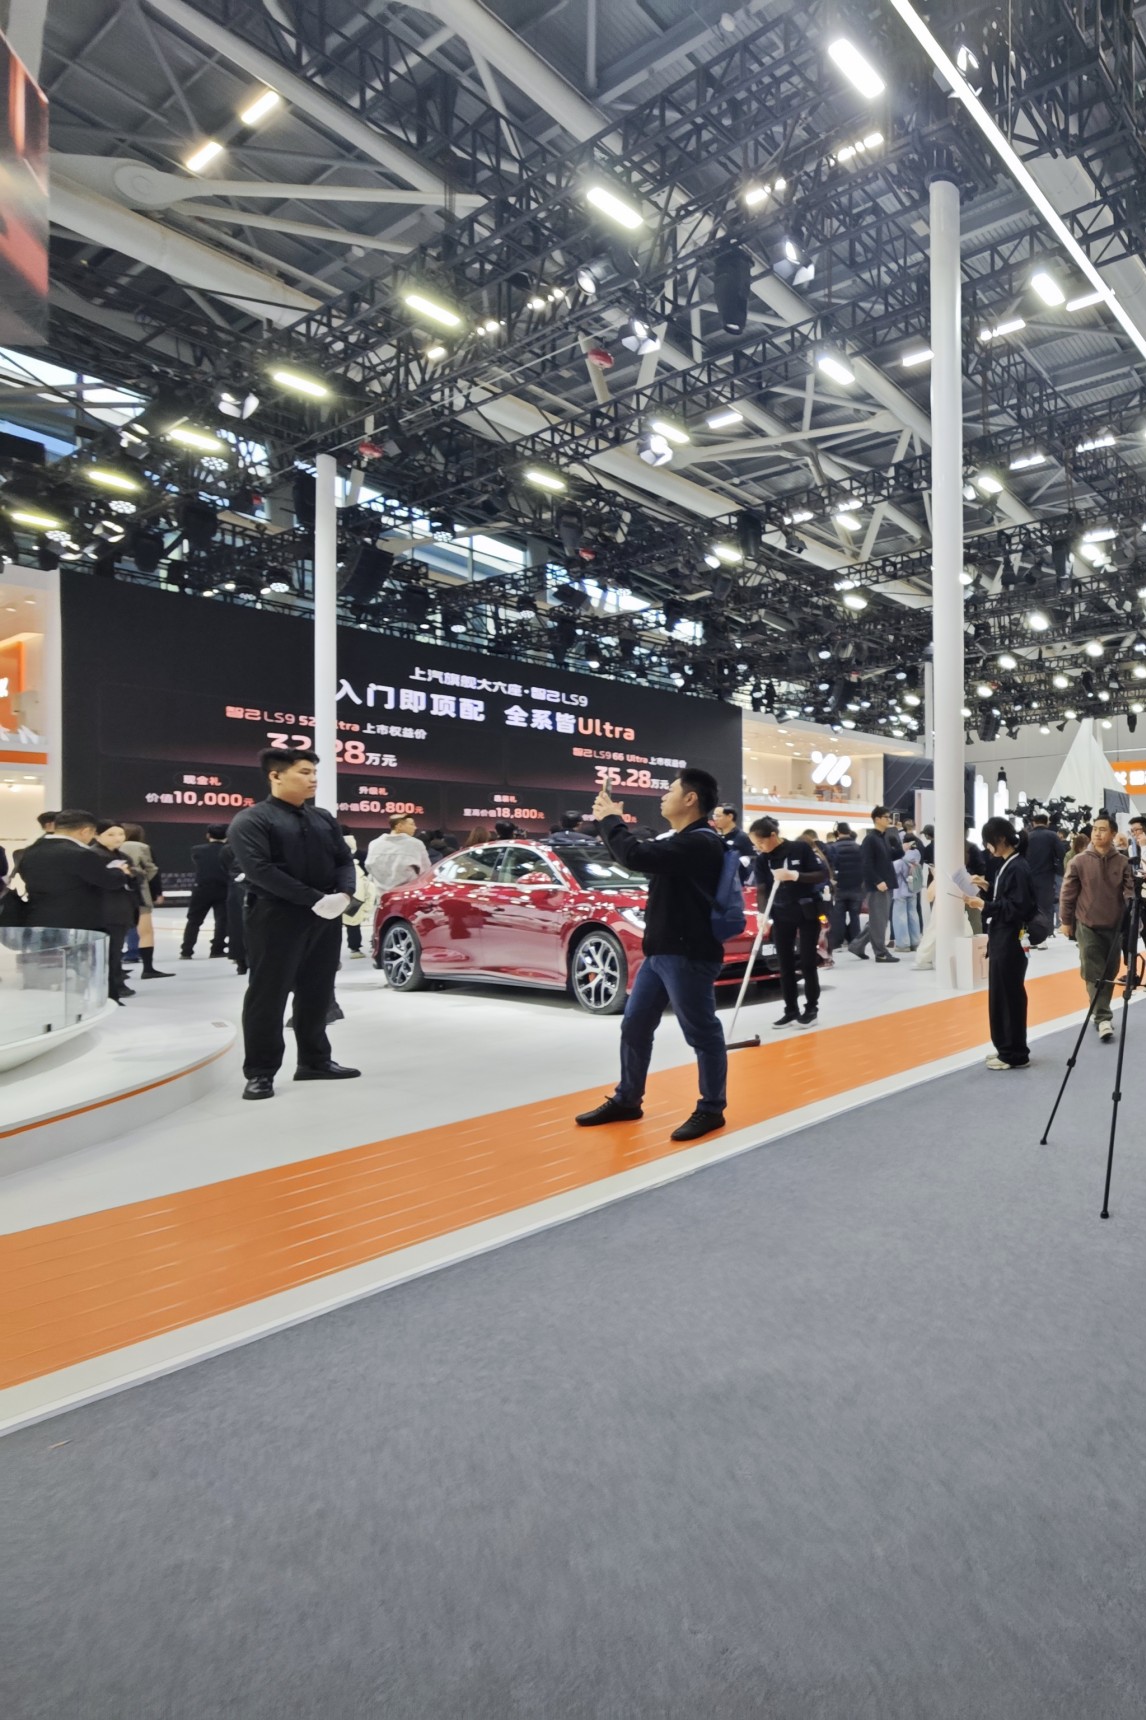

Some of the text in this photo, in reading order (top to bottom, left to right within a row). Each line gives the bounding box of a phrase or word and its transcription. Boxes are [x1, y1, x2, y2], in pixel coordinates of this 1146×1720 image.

[335, 678, 636, 742] 入门即顶配 全系皆Ultra
[145, 790, 256, 807] 价值10,000元
[336, 800, 425, 815] 价值60,800元
